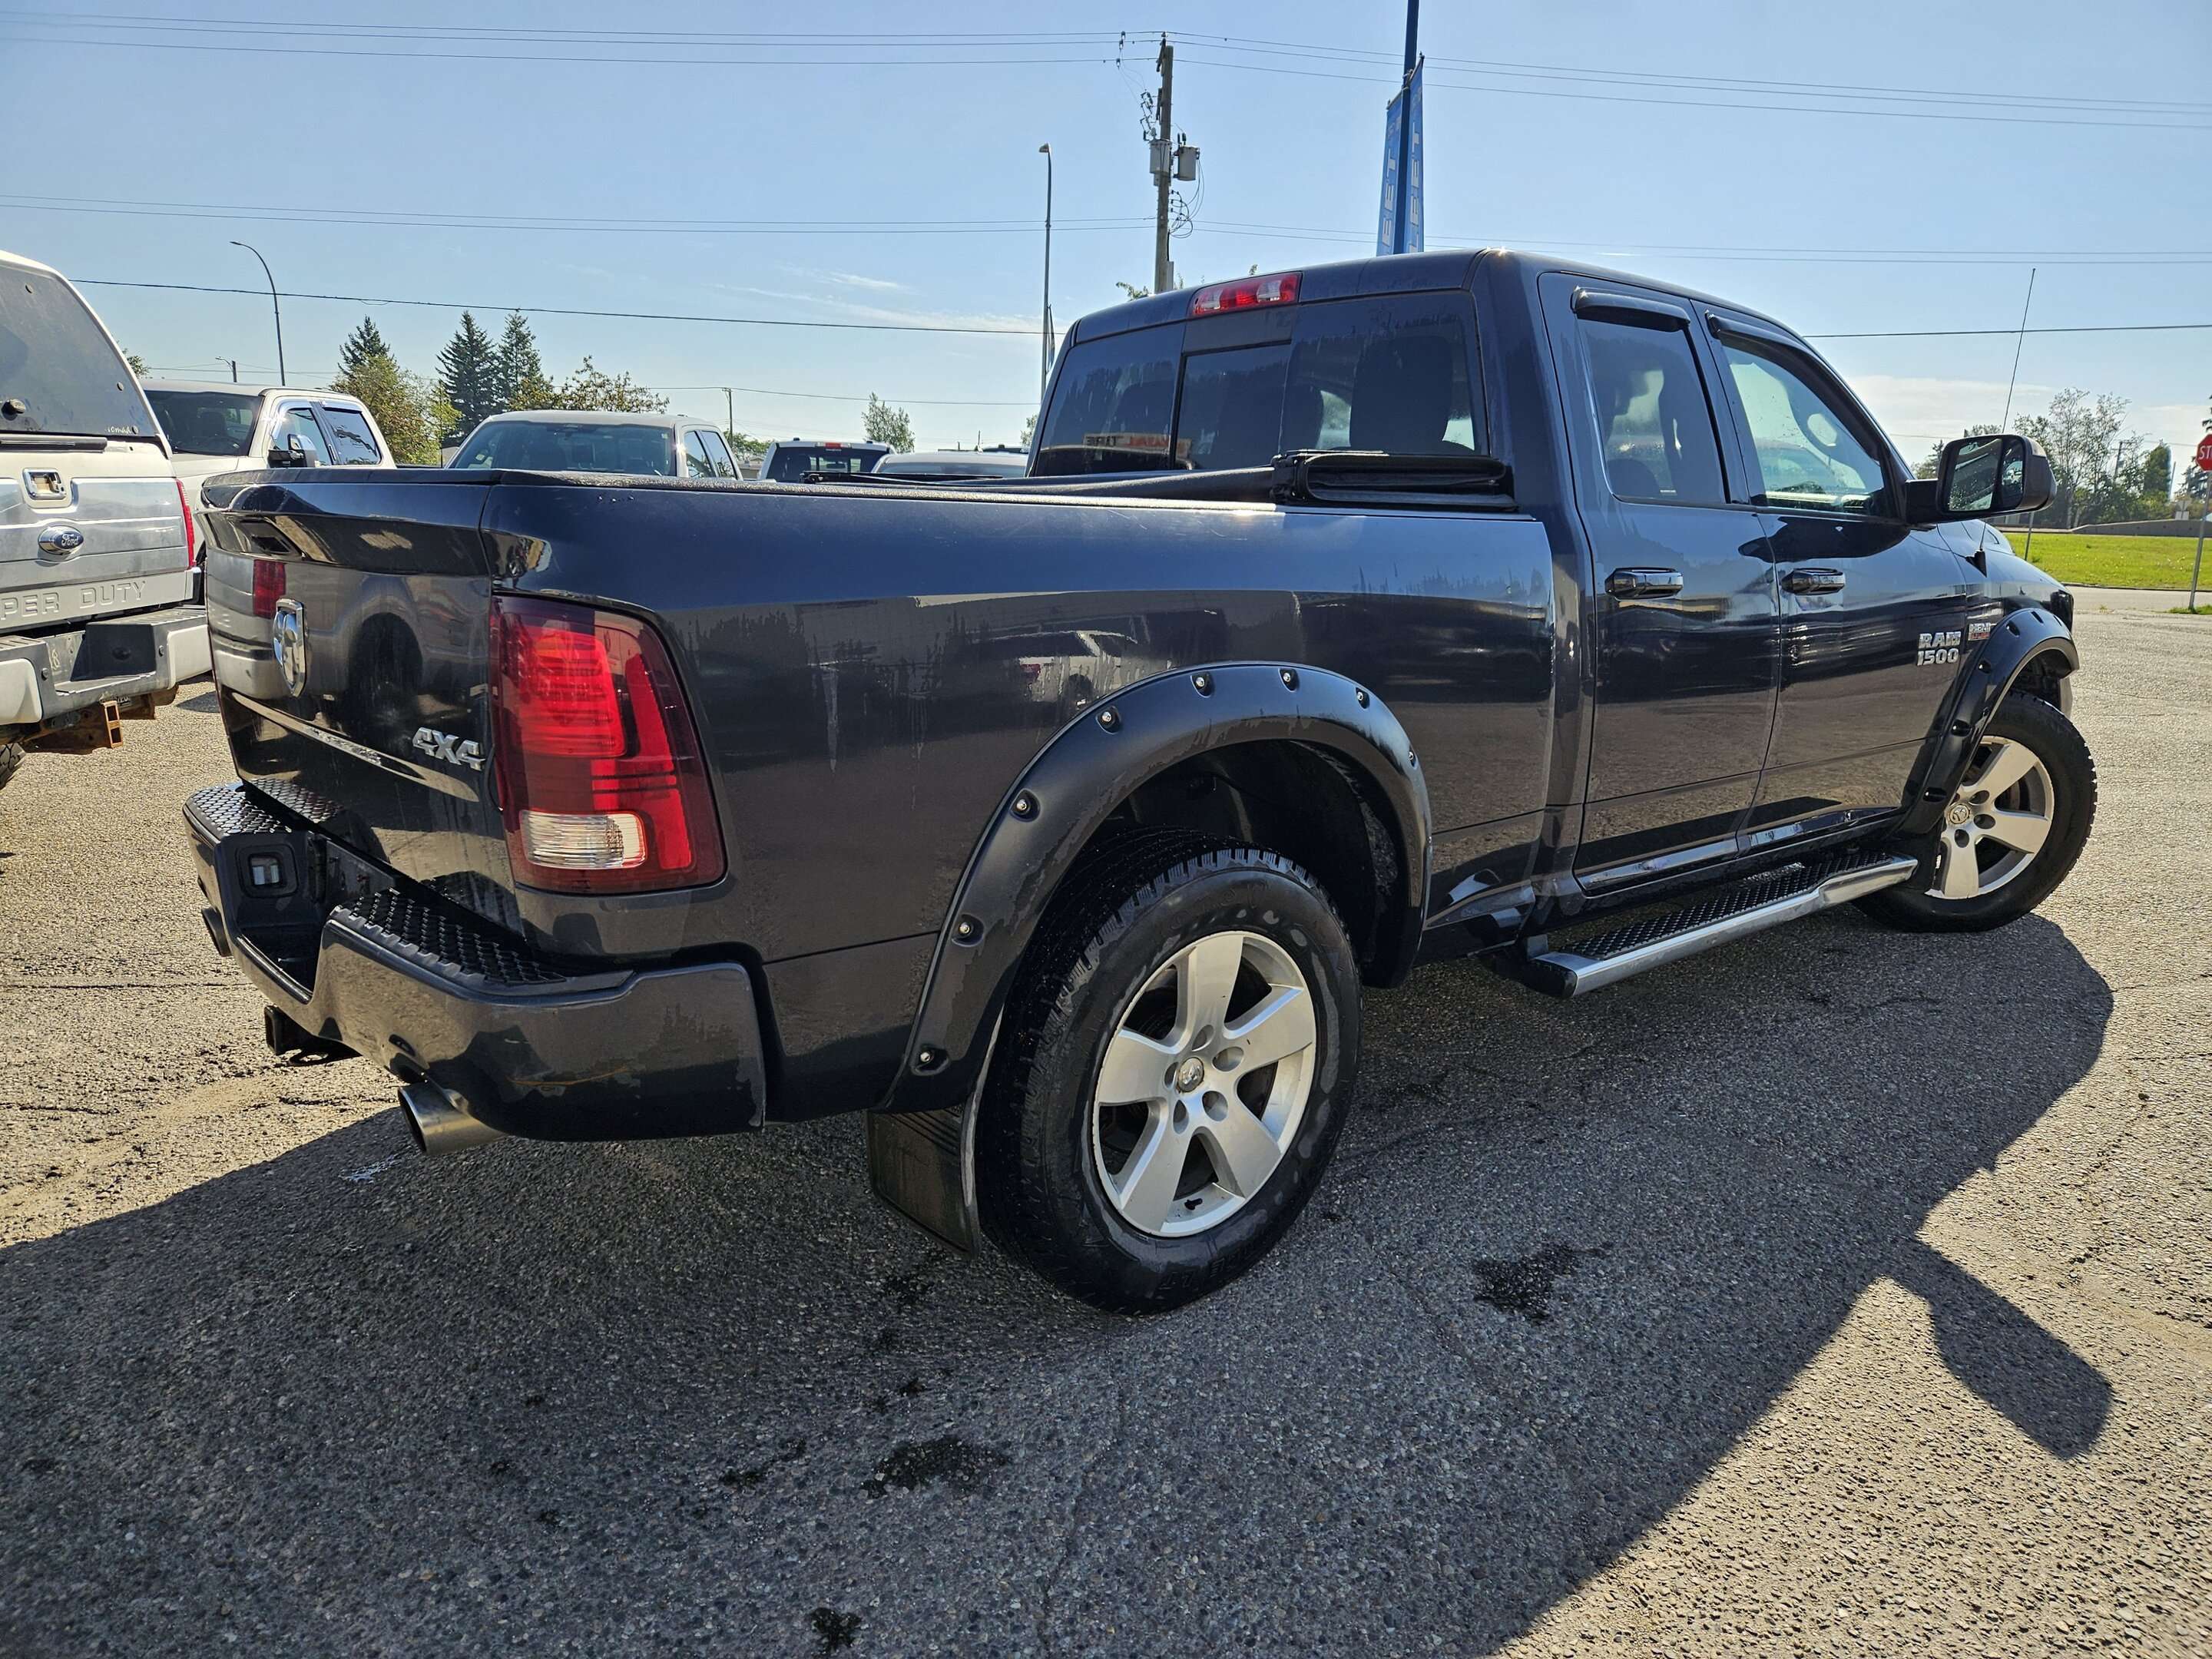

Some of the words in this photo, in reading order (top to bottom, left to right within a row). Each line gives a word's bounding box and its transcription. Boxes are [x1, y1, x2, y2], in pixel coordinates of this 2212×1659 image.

[2199, 445, 2212, 459] ST
[61, 533, 80, 546] Ford
[0, 591, 59, 620] PER
[80, 581, 146, 609] DUTY
[1919, 631, 1962, 649] RAM
[1917, 647, 1959, 666] 1500
